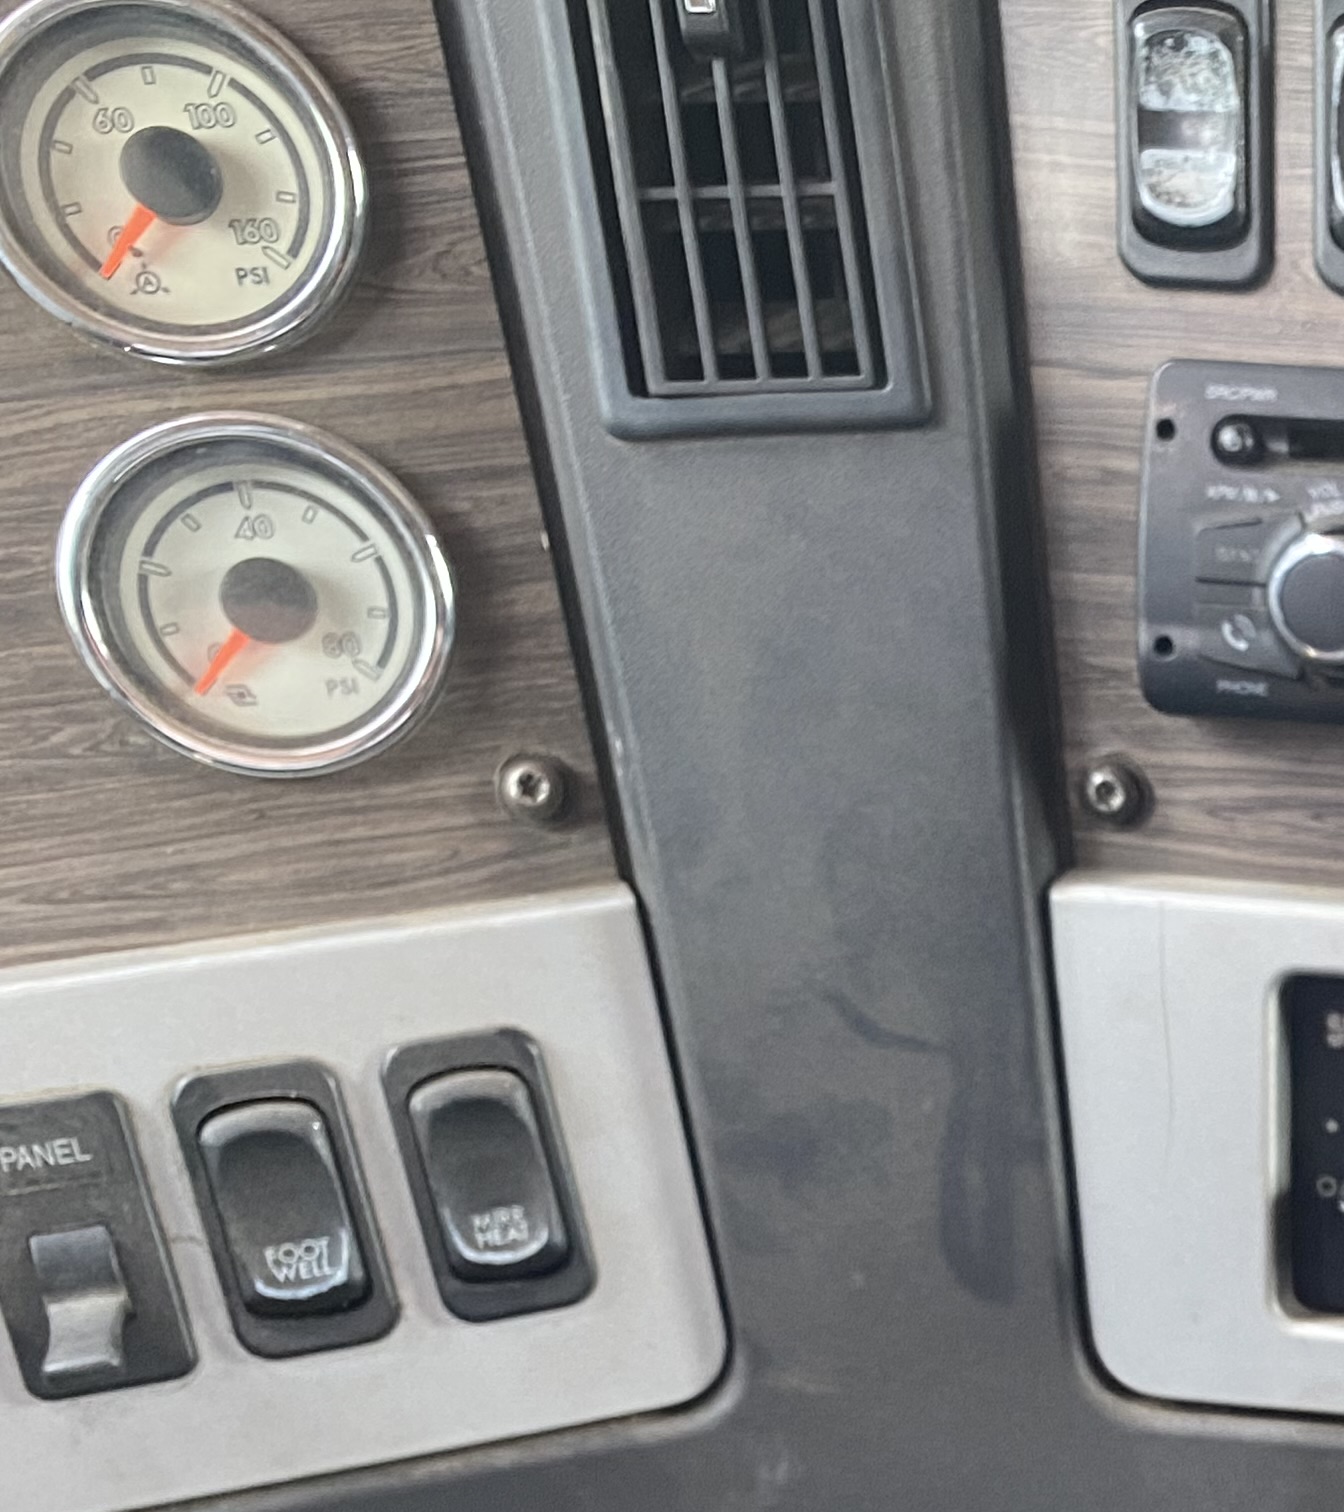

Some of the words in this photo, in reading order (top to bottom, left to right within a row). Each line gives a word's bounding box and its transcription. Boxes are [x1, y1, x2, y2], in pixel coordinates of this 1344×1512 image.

[92, 107, 135, 134] 60
[184, 102, 236, 129] 100
[228, 217, 281, 246] 160
[235, 266, 270, 286] PSI
[234, 513, 275, 541] 40
[325, 677, 361, 697] PSI
[0, 1136, 94, 1172] PANEL
[265, 1235, 331, 1272] FOOT
[270, 1254, 342, 1284] WELL
